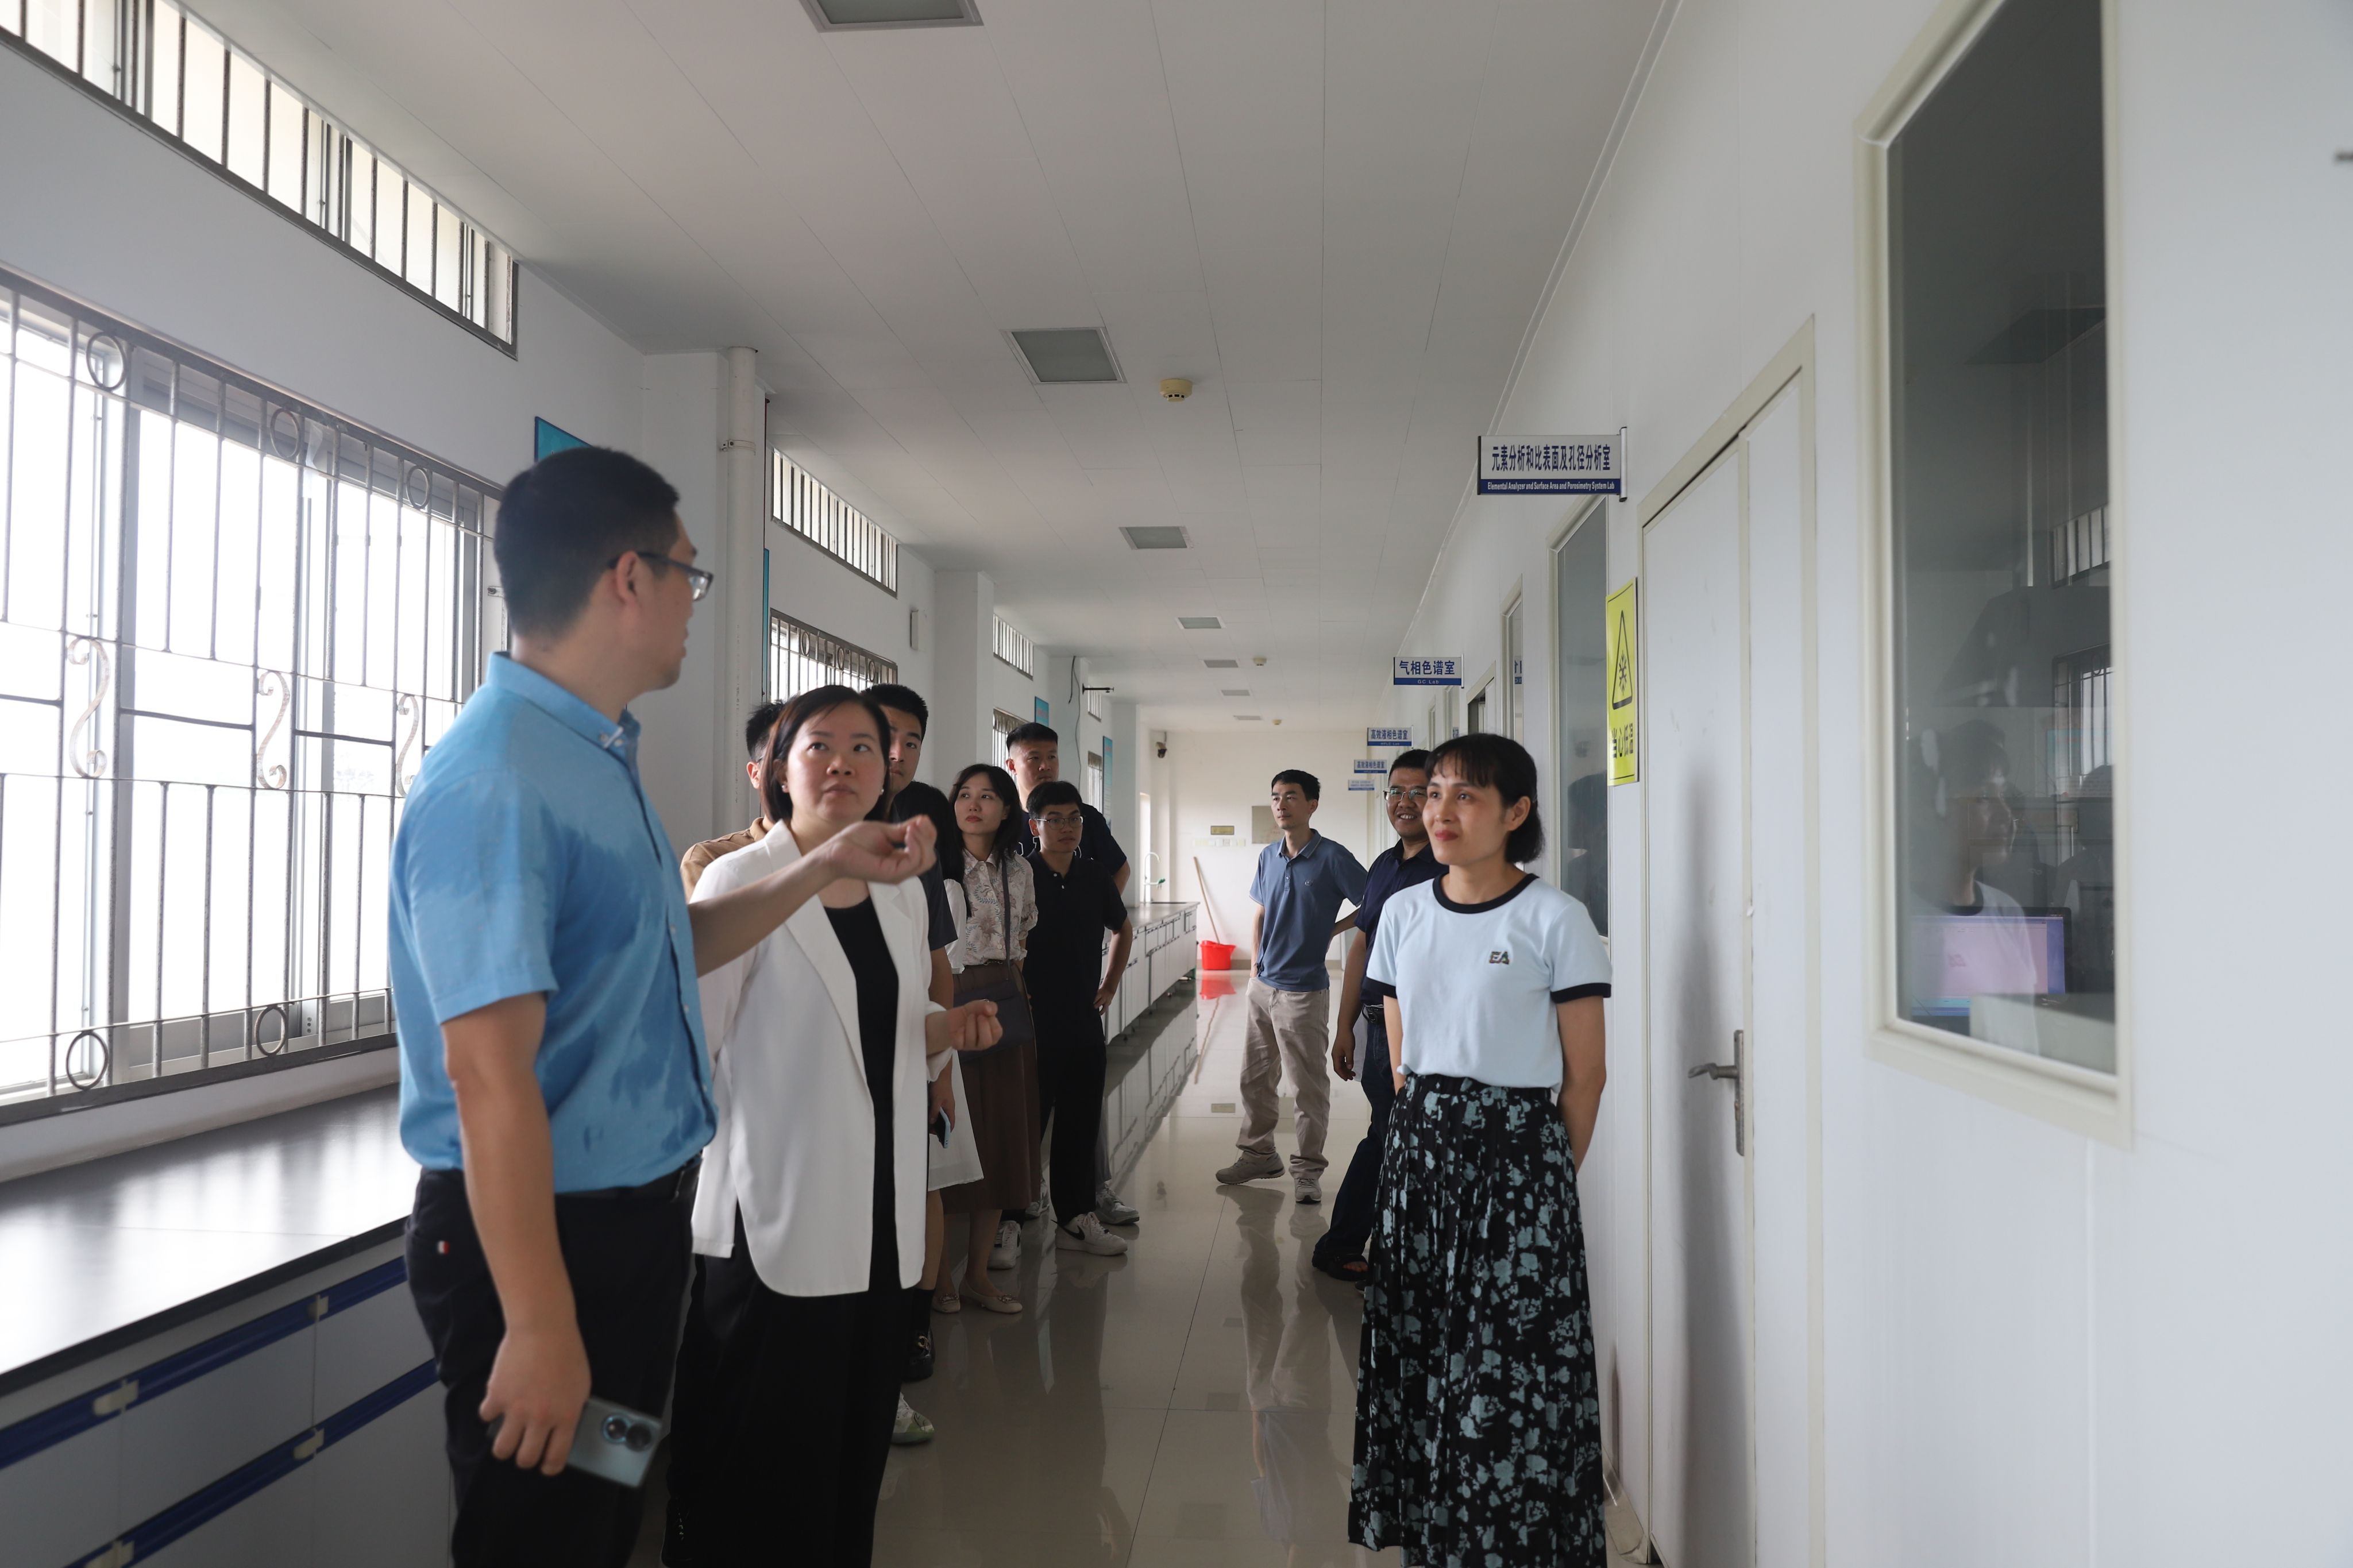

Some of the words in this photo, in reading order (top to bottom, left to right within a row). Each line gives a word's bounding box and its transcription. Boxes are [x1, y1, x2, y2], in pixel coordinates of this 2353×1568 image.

[1492, 444, 1610, 472] 元素分析和比表面及孔径分析室
[1488, 481, 1508, 490] Elemental
[1508, 482, 1526, 491] Analyzer
[1534, 482, 1549, 490] Surface
[1549, 482, 1559, 490] Area
[1567, 482, 1591, 491] Porosimetry
[1591, 482, 1607, 491] System
[1399, 661, 1455, 675] 气相色谱室
[1371, 729, 1407, 740] 高效液相色谱室
[1490, 951, 1510, 964] EA
